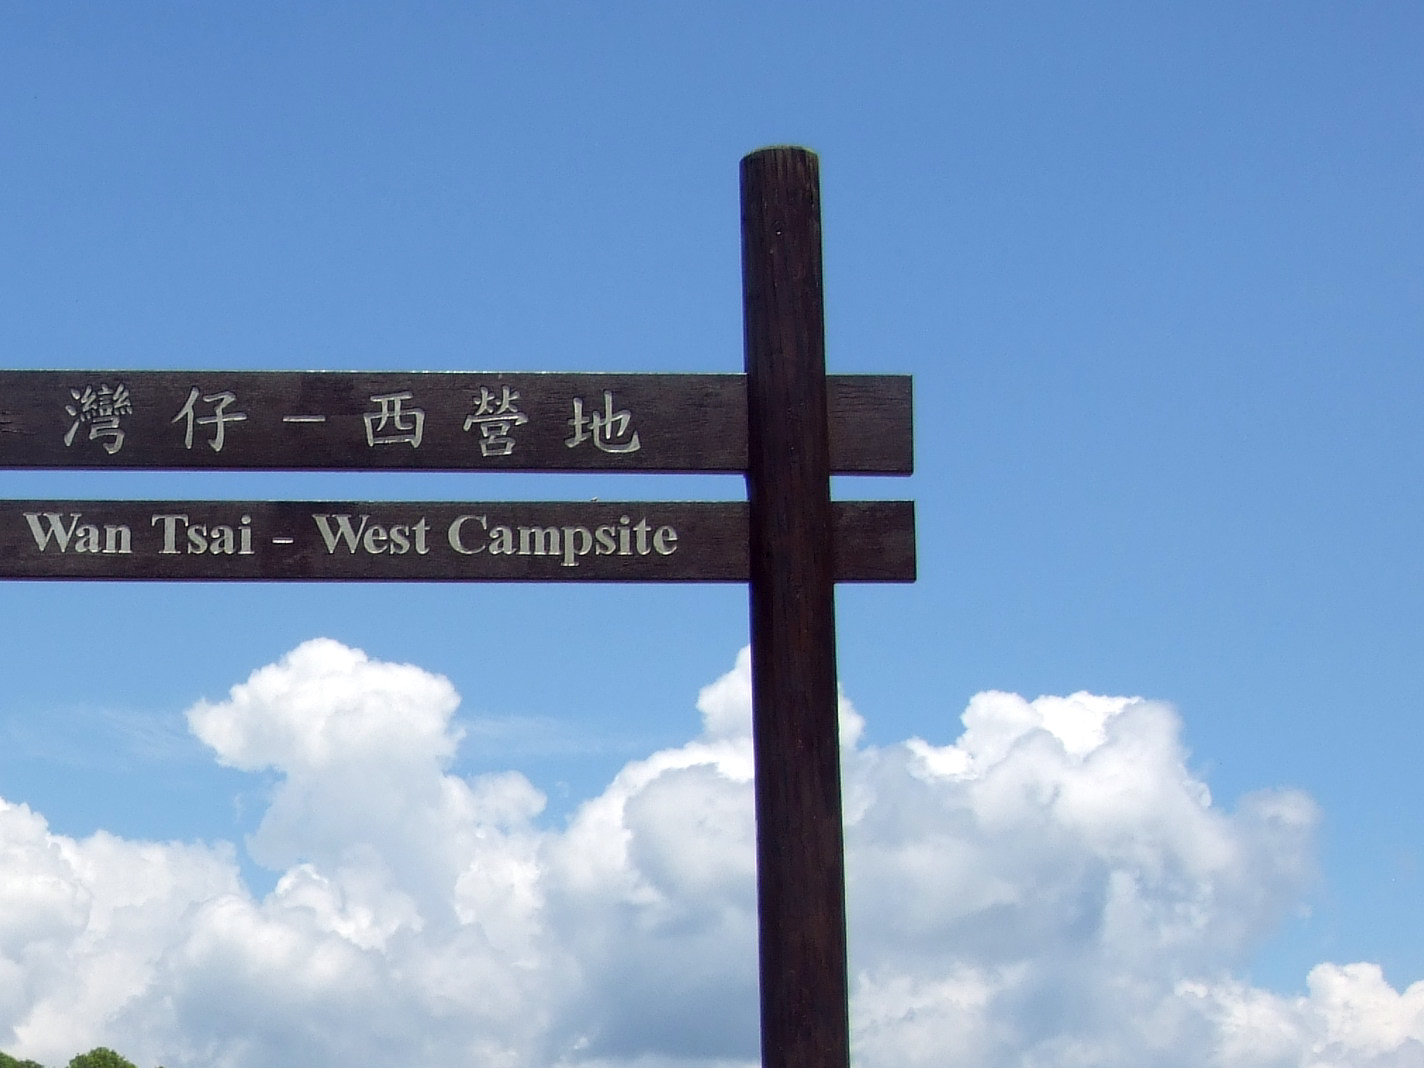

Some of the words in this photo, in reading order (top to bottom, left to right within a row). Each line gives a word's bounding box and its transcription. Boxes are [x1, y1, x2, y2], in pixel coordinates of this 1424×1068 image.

[23, 512, 132, 553] Wan
[151, 513, 255, 554] Tsai
[312, 513, 430, 554] West
[447, 514, 678, 567] Campsite
